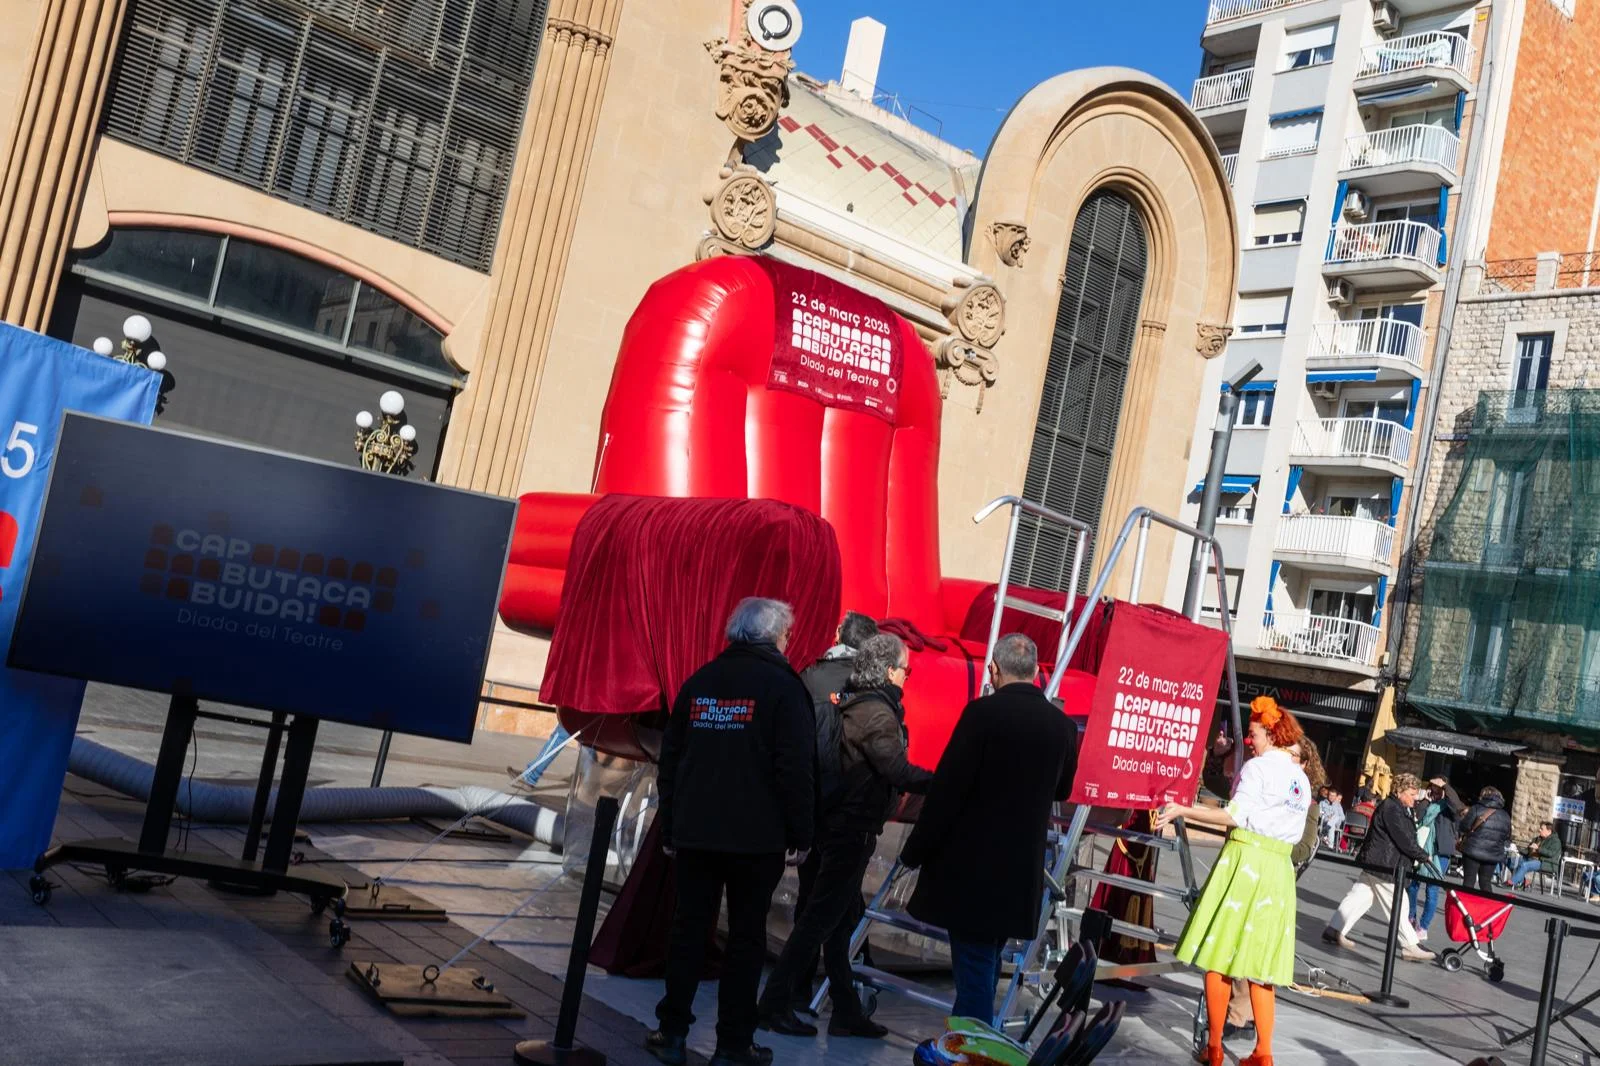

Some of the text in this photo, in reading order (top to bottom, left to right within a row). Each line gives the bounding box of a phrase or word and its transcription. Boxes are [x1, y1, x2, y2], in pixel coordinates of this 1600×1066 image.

[791, 291, 890, 335] 22 de març 2025
[803, 311, 831, 331] CAP
[820, 331, 881, 361] BUTACA
[800, 354, 879, 387] Diada del Teatre
[175, 528, 250, 559] CAP
[221, 562, 371, 609] BUTACA
[190, 581, 317, 624] BUIDA!
[176, 607, 344, 652] Diada del Teatre
[1117, 666, 1204, 701] 22 de març 2025
[696, 697, 717, 705] CAP
[708, 705, 748, 714] BUTACA
[1123, 694, 1151, 715] CAP
[693, 720, 713, 729] Diada
[1137, 715, 1190, 741] BUTACA
[1125, 732, 1169, 755] BUIDA!
[1112, 755, 1139, 772] Diada
[1140, 759, 1154, 774] del
